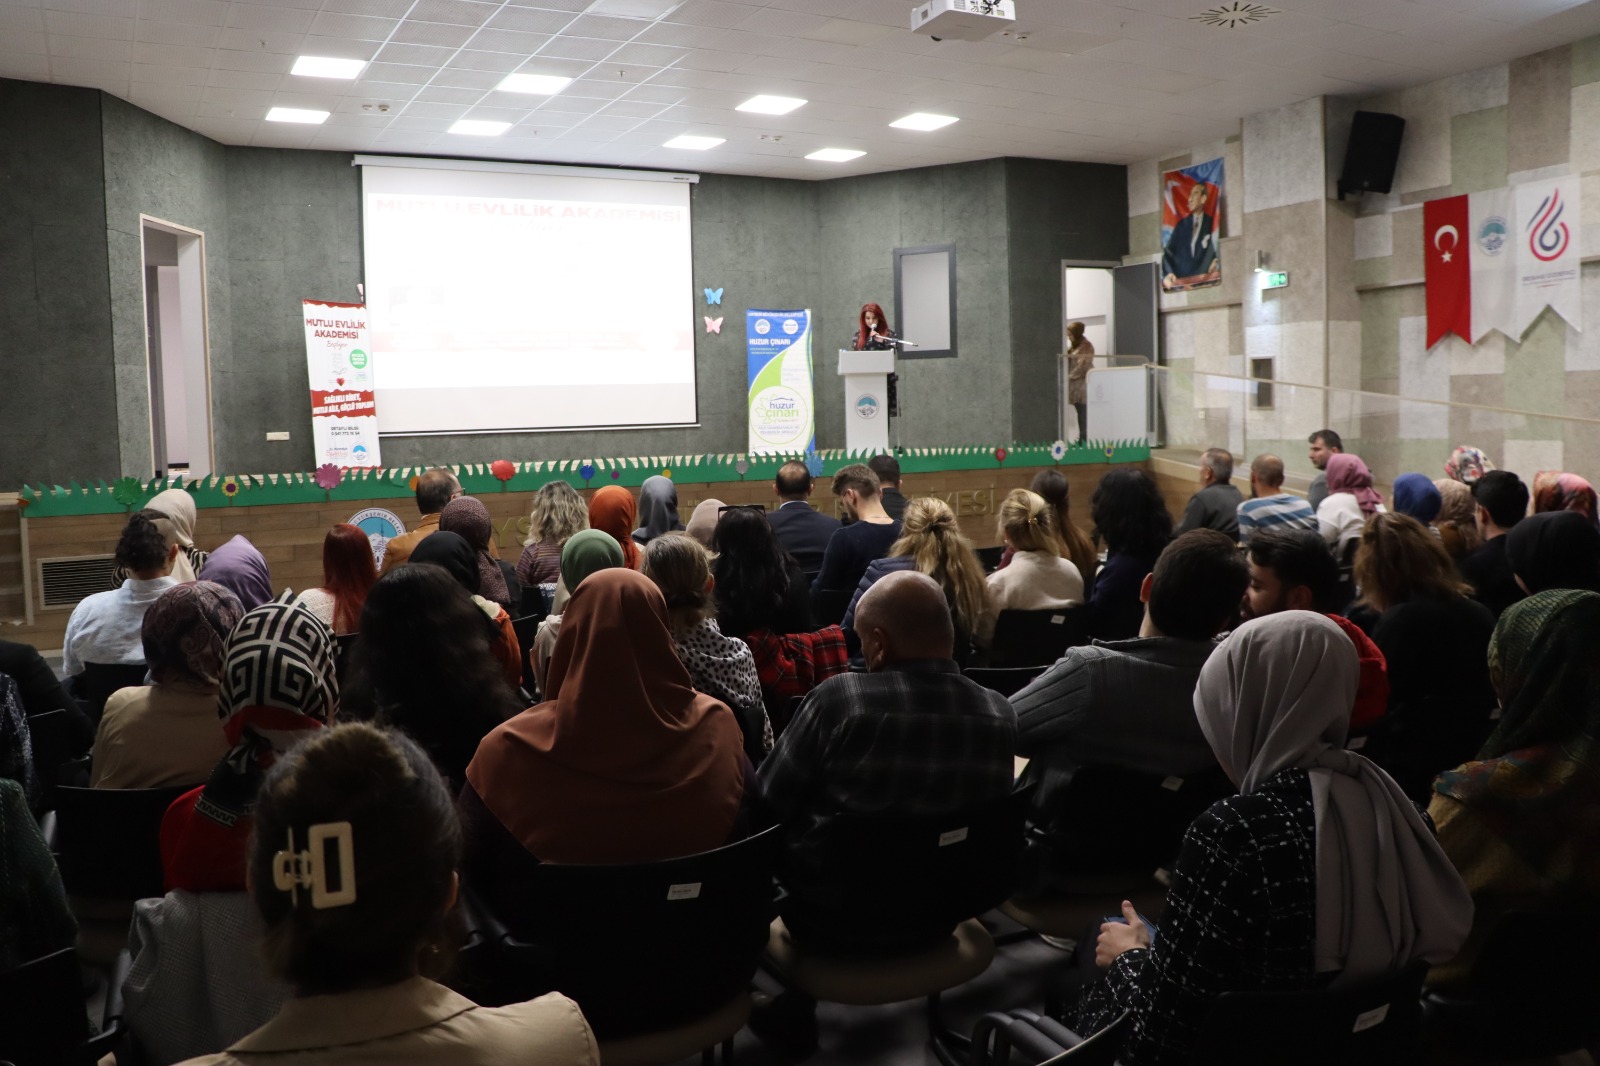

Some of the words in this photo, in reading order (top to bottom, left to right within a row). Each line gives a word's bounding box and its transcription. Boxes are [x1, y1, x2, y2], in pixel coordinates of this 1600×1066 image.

[306, 318, 333, 328] MUTLU
[335, 319, 366, 329] EVLİLİK
[314, 329, 359, 339] AKADEMİSİ
[770, 338, 791, 346] ÇINARI
